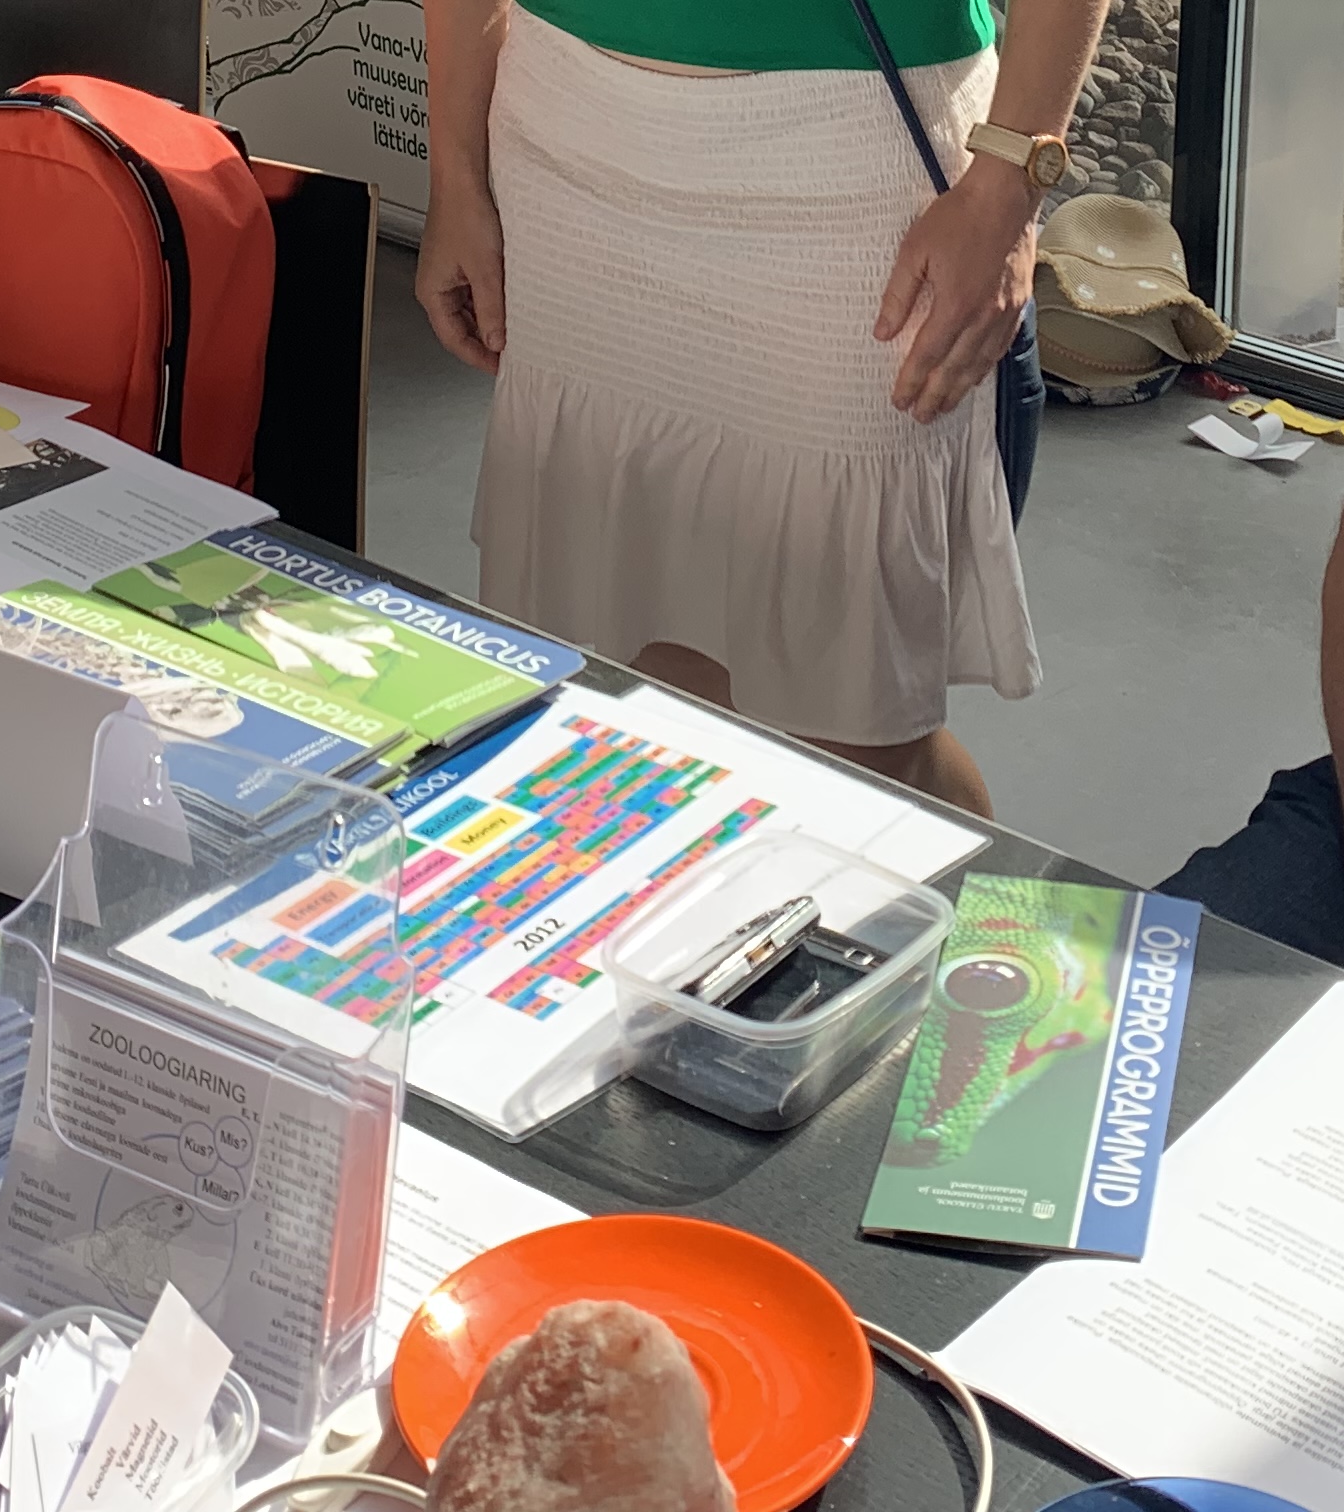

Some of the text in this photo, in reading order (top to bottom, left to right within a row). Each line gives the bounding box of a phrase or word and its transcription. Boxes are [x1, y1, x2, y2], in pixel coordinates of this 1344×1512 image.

[347, 86, 430, 128] väreti võr
[374, 121, 427, 160] lättide
[228, 534, 364, 599] HORTUS
[358, 586, 551, 676] BOTANICUS
[19, 589, 122, 635] ЗЕМЛЯ
[125, 626, 228, 682] ЖИЗНЬ
[234, 671, 384, 739] ИСТОРИЯ
[394, 769, 460, 814] LIKOOL
[460, 817, 508, 846] Money
[513, 917, 567, 953] 2012
[89, 1023, 246, 1104] ZOOLOOGIARING
[1092, 924, 1191, 1208] ÕPPEPROGRAMMID
[184, 1138, 214, 1159] Kus?
[220, 1130, 248, 1152] Mis?
[202, 1178, 239, 1203] Millal?
